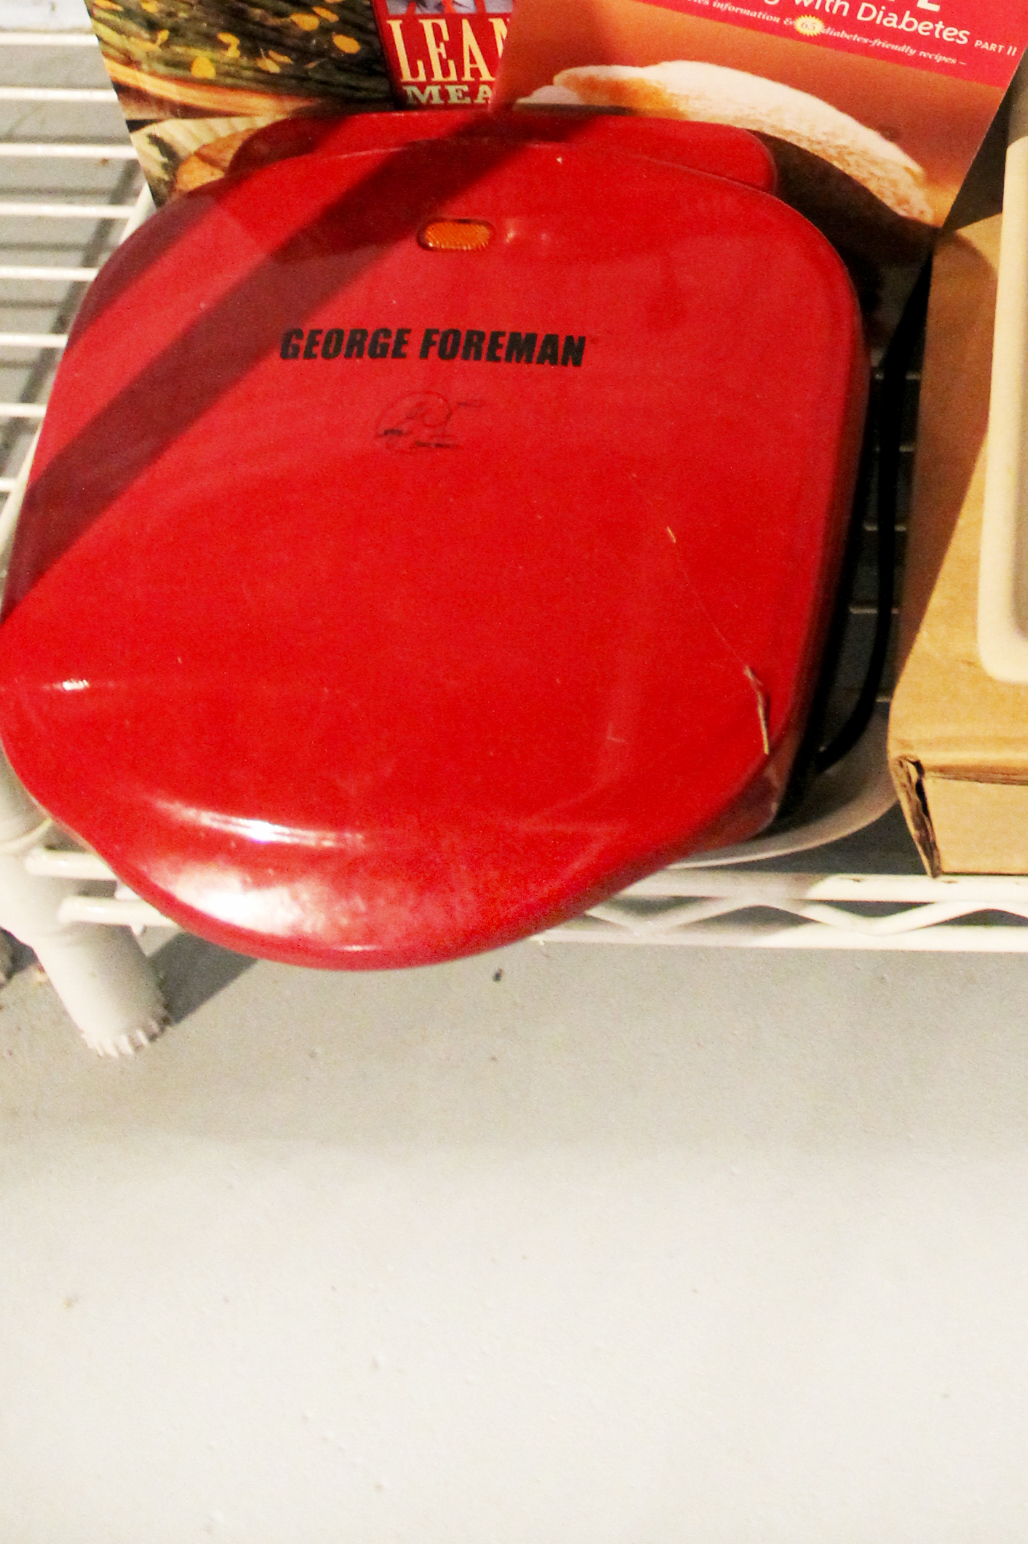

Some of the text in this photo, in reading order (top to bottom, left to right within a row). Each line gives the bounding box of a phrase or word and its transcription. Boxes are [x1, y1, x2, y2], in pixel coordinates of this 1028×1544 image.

[712, 0, 781, 24] information
[821, 25, 917, 56] diabetes-friendly
[919, 49, 957, 66] recipes
[856, 2, 970, 45] Diabetes
[974, 39, 1004, 54] PART
[1007, 45, 1017, 57] II
[279, 328, 587, 367] GEORGE FOREMAN
